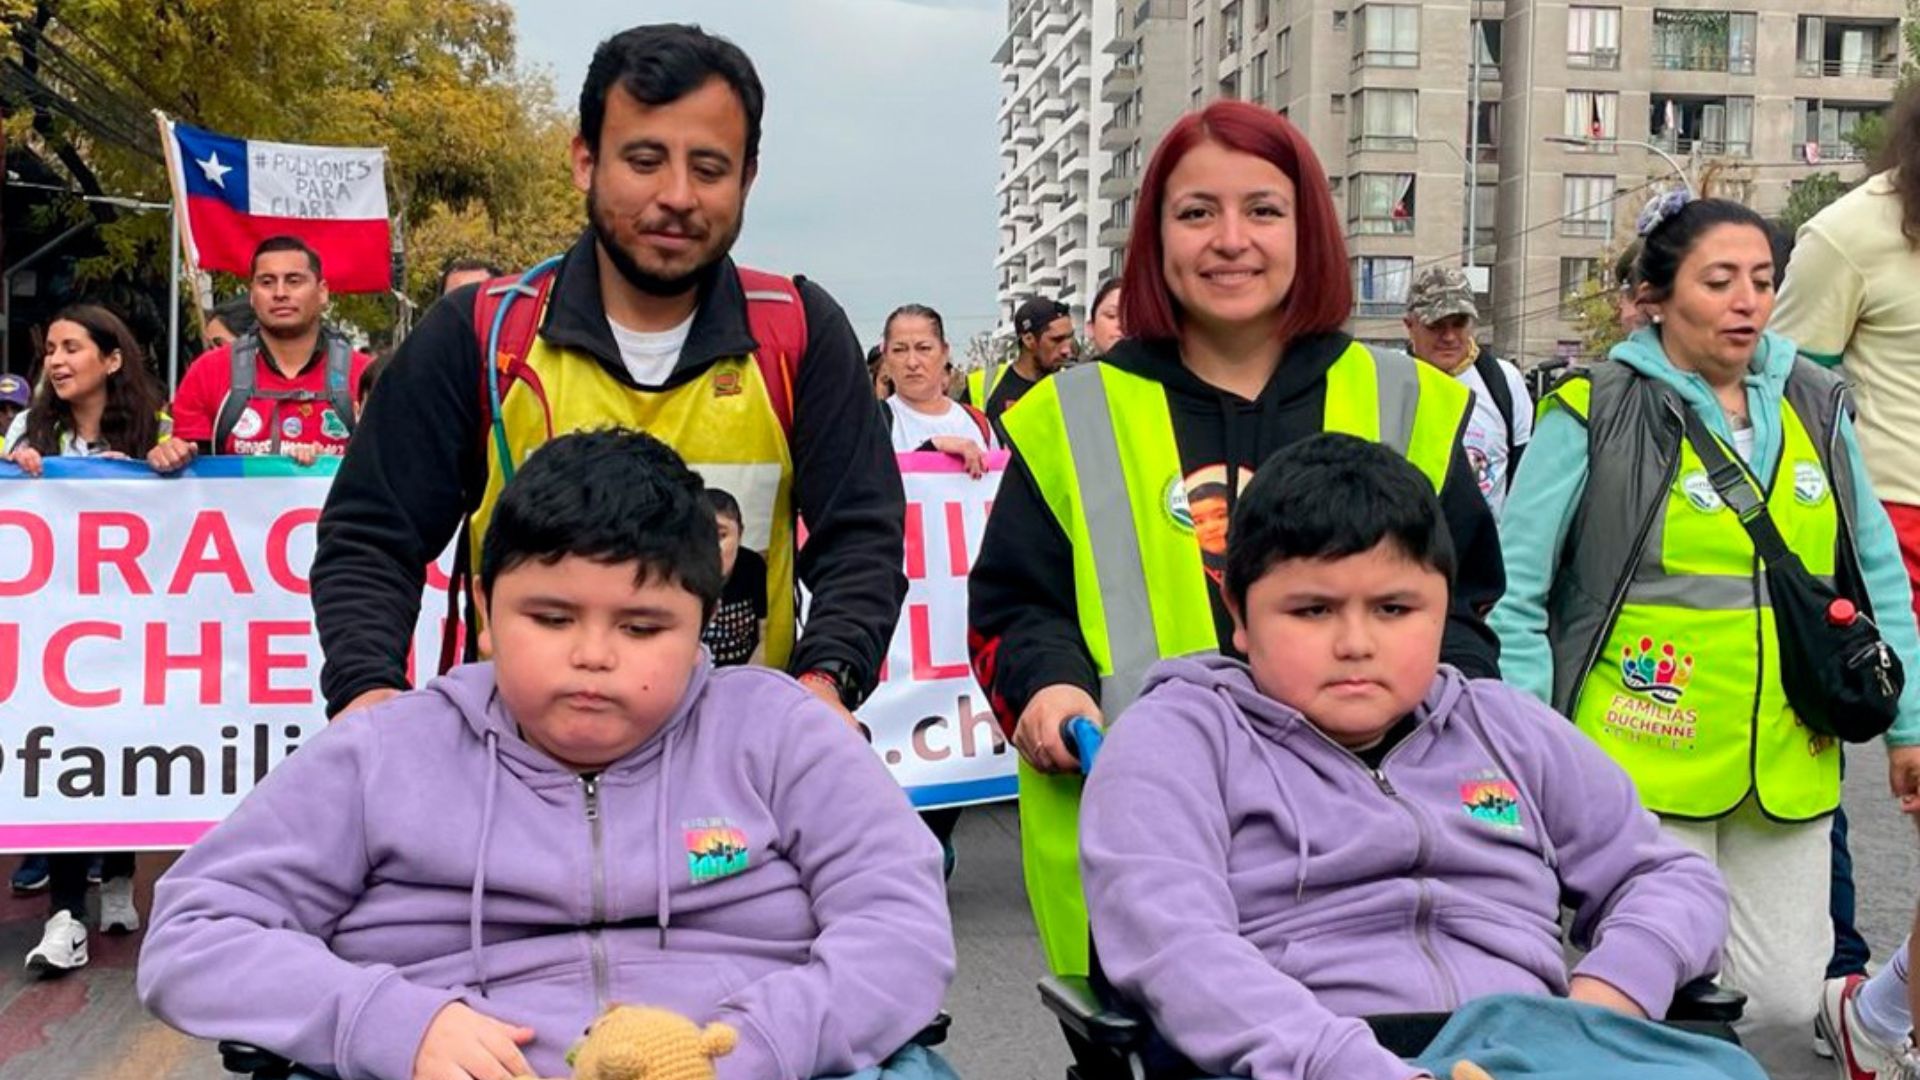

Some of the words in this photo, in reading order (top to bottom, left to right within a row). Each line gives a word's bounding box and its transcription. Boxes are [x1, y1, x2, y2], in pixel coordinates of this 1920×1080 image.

[296, 179, 352, 201] PARA
[271, 197, 338, 217] CLARA
[1612, 695, 1697, 724] FAMILIAS
[1607, 710, 1695, 738] DUCHENNE
